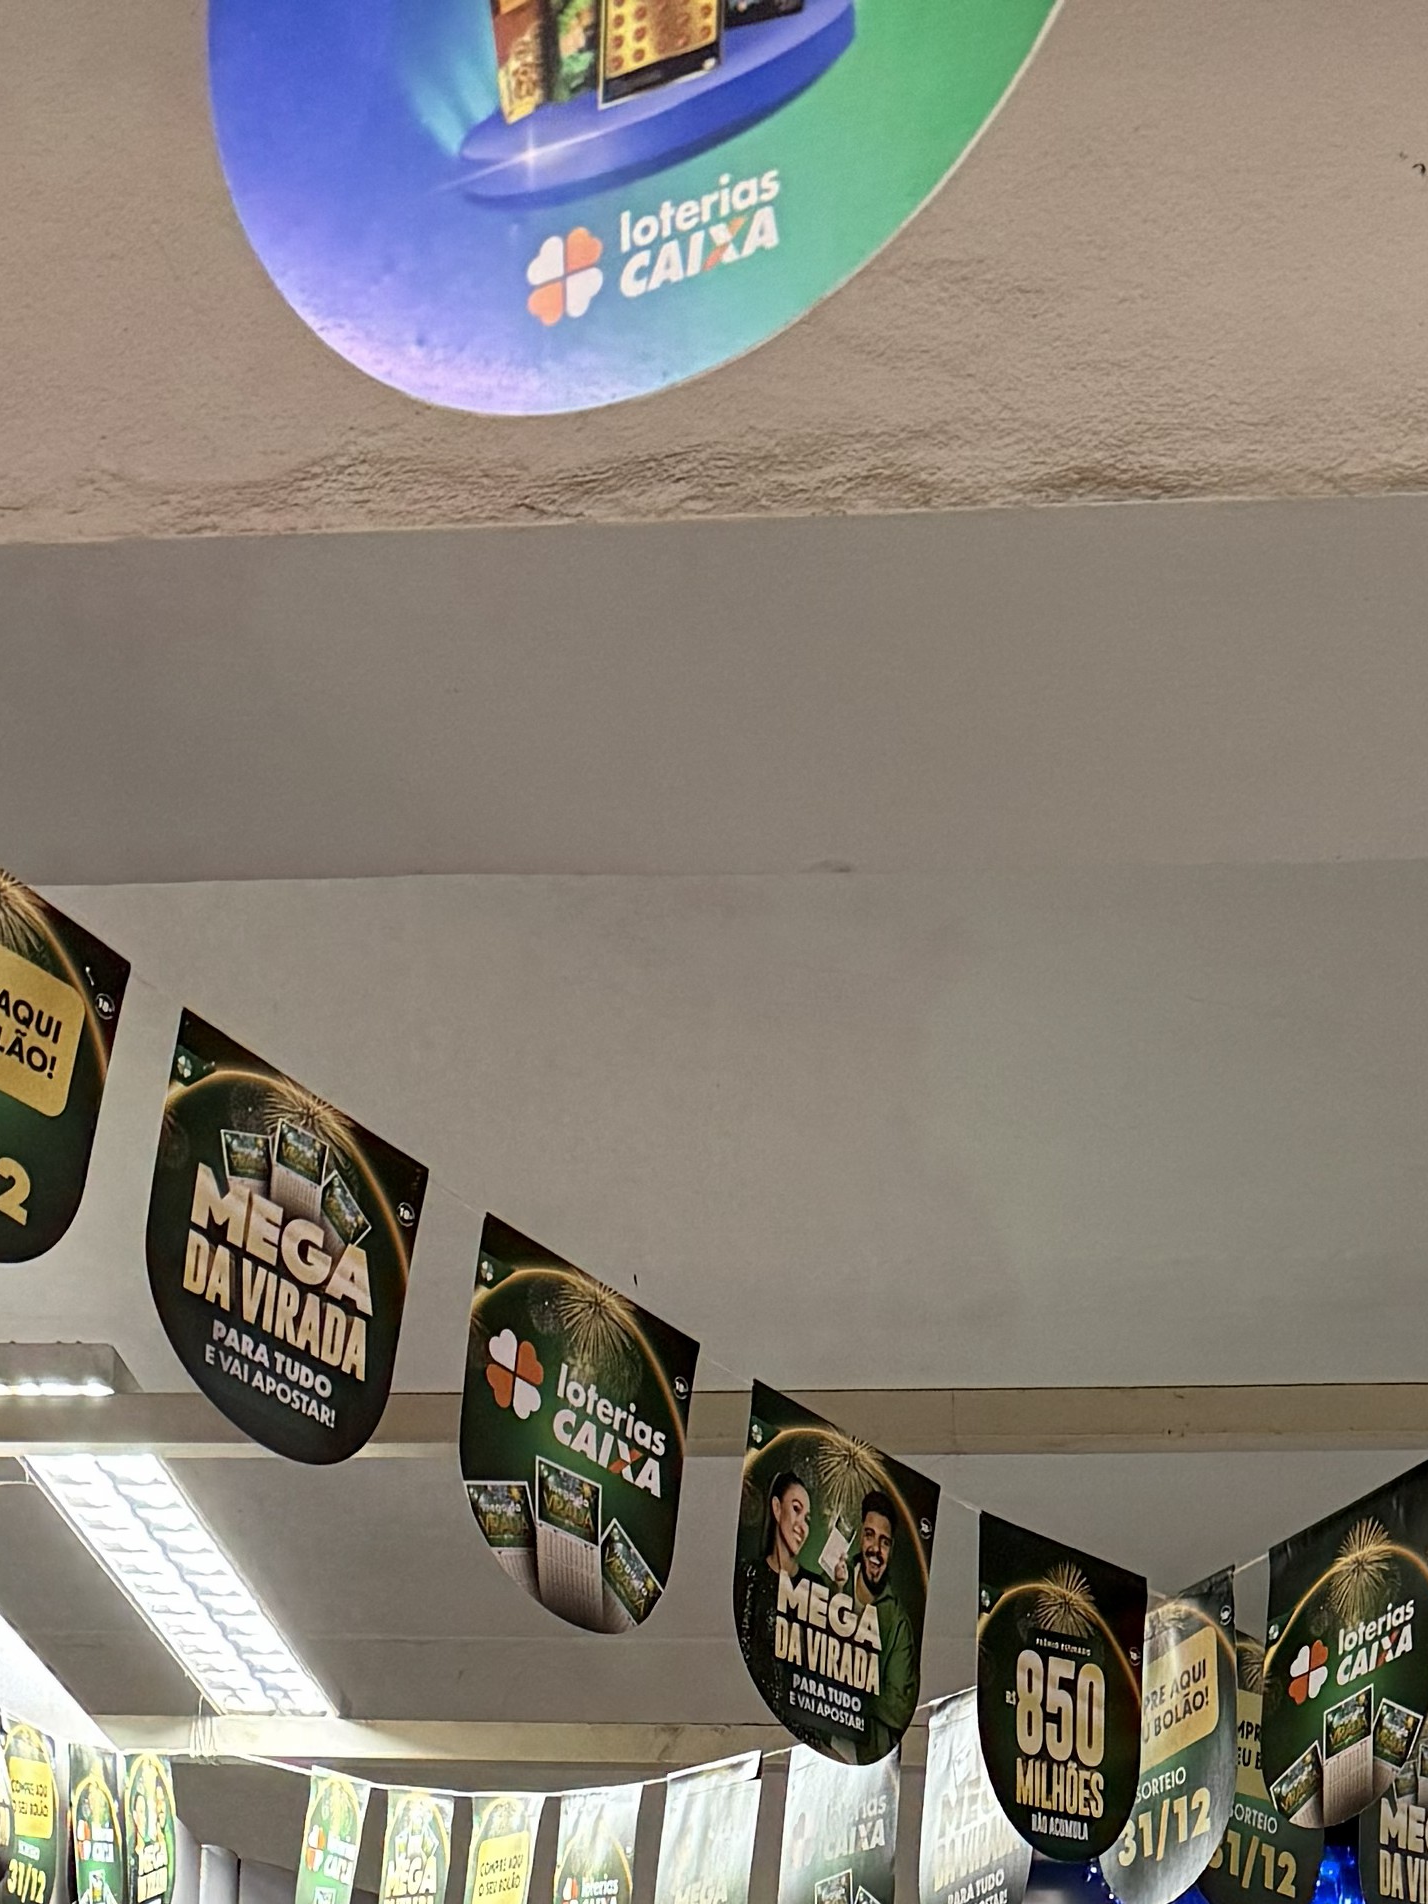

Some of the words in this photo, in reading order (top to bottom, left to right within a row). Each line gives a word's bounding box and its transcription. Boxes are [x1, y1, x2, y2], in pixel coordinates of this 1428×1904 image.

[620, 170, 780, 252] loterias
[620, 206, 778, 298] CAIXA
[191, 1162, 373, 1317] MEGA
[183, 1229, 230, 1312] DA
[242, 1258, 366, 1382] VIRADA
[213, 1320, 269, 1368] PARA
[274, 1351, 332, 1398] TUDO
[557, 1362, 666, 1457] loterias
[553, 1408, 661, 1498] CAIXA
[816, 1700, 865, 1732] APOSTAR!
[1154, 1686, 1209, 1737] BOLÃO!
[1016, 1757, 1104, 1818] MILHÕES
